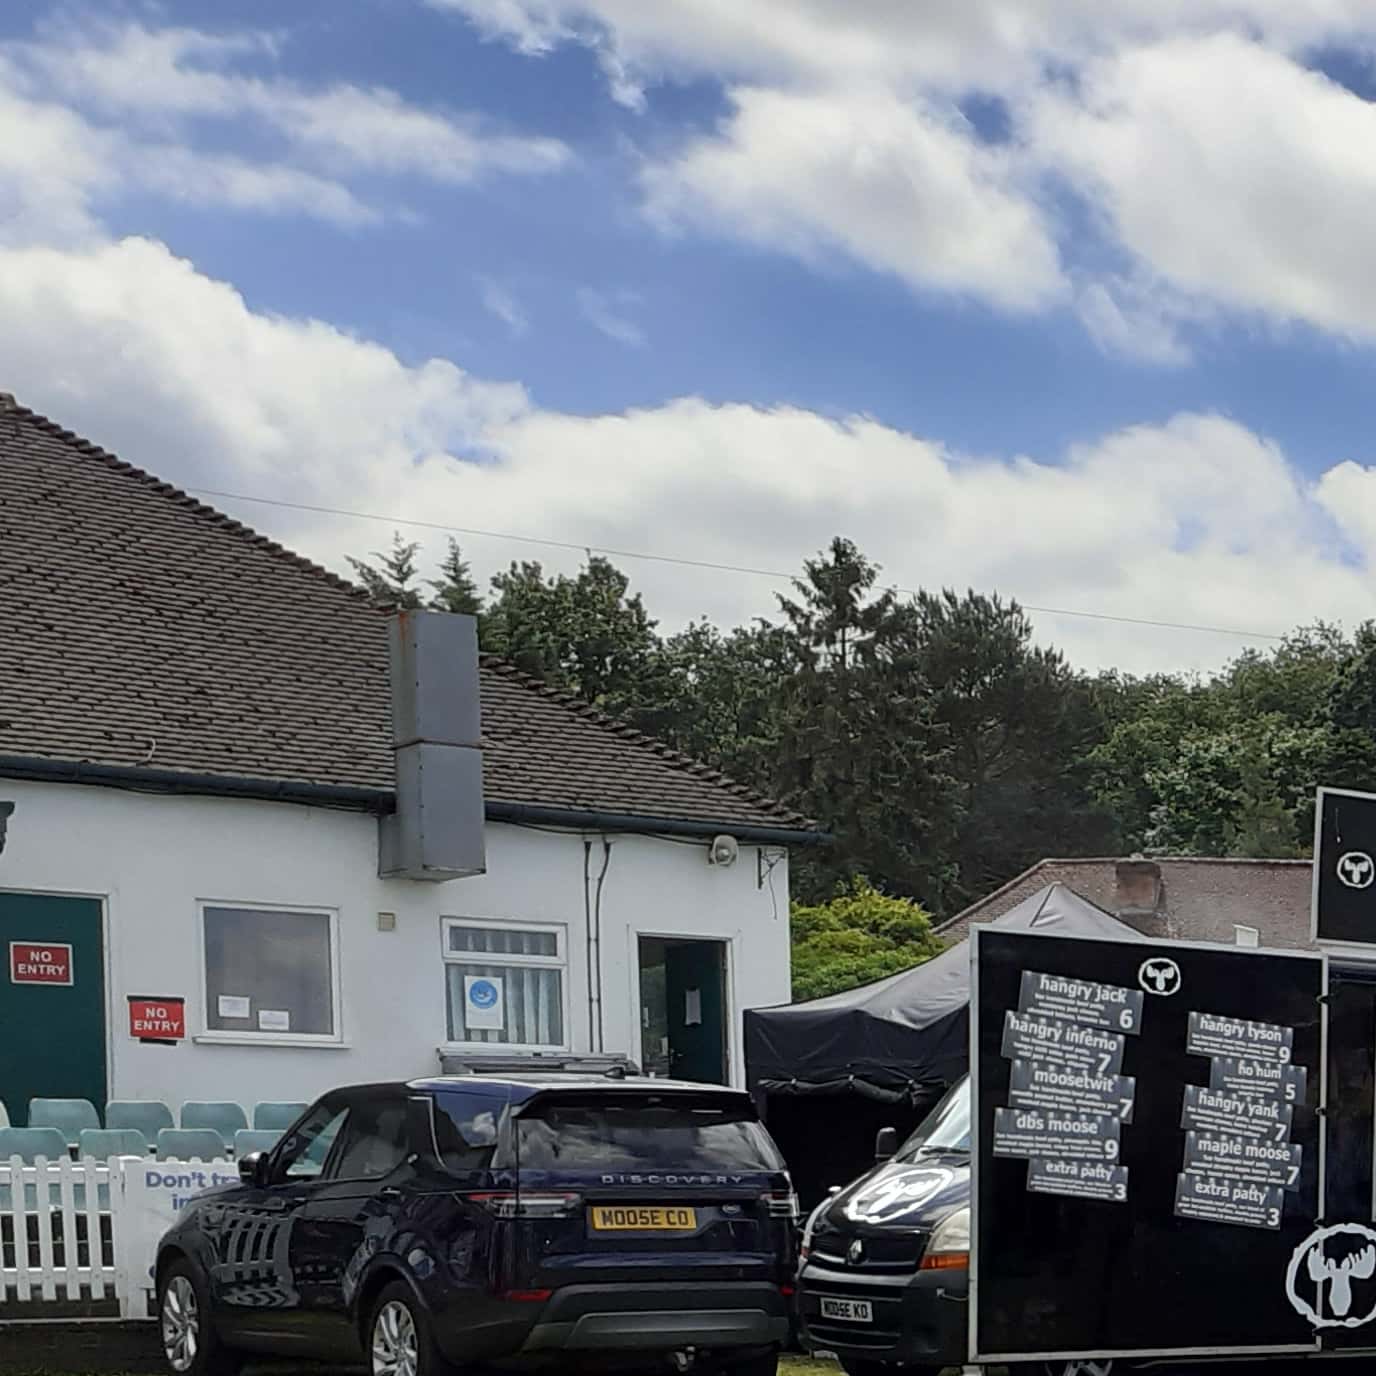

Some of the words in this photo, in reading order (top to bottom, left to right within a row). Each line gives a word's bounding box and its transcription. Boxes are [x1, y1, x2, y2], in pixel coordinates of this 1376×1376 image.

[30, 951, 52, 962] NO
[18, 964, 65, 976] ENTRY
[1040, 975, 1092, 1000] hangry
[1094, 984, 1127, 1003] jack
[146, 1007, 167, 1019] NO
[1120, 1009, 1133, 1029] 6
[134, 1020, 180, 1032] ENTRY
[1010, 1015, 1062, 1042] hangry
[1066, 1026, 1118, 1051] inferno
[1200, 1017, 1246, 1039] hangry
[1248, 1024, 1282, 1043] tyson
[1098, 1053, 1112, 1073] 7
[1279, 1046, 1291, 1064] 9
[1256, 1063, 1281, 1079] hum
[1285, 1083, 1296, 1100] 5
[1120, 1098, 1133, 1118] 7
[1198, 1090, 1246, 1115] hangry
[1248, 1101, 1279, 1119] yank
[1016, 1115, 1044, 1130] dbs
[1048, 1120, 1098, 1135] moose
[1275, 1123, 1287, 1141] 7
[1104, 1140, 1119, 1160] 9
[1198, 1140, 1242, 1157] maple
[1245, 1146, 1291, 1162] moose
[145, 1171, 207, 1189] Don't
[601, 1175, 743, 1185] DISCOVERY
[1046, 1161, 1078, 1175] extra
[1081, 1164, 1113, 1181] patty
[1287, 1166, 1299, 1185] 7
[1114, 1183, 1127, 1200] 3
[1195, 1182, 1229, 1197] extra
[1233, 1186, 1266, 1205] patty
[1267, 1208, 1280, 1226] 3
